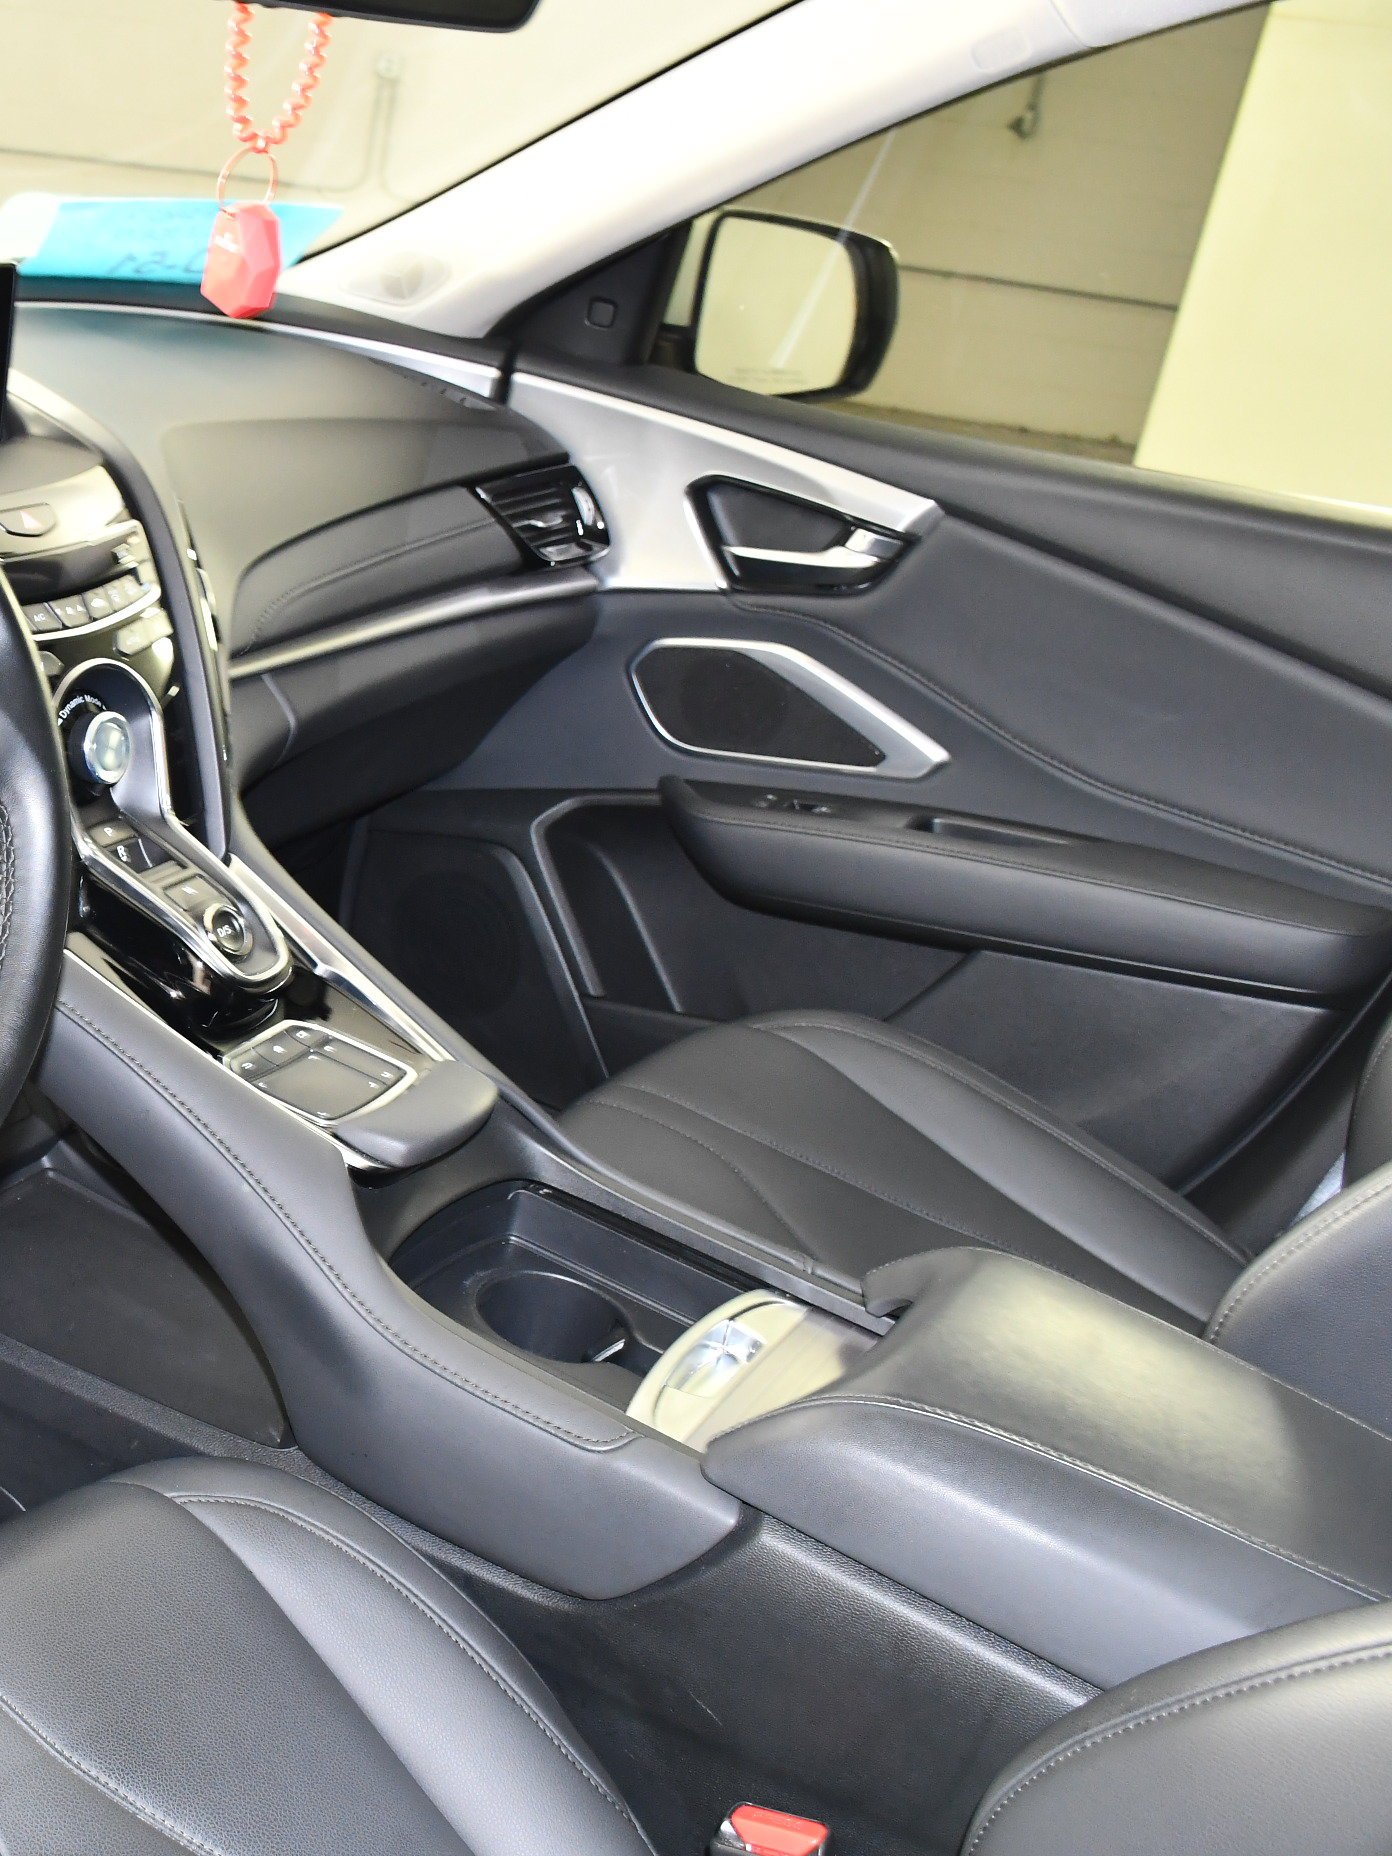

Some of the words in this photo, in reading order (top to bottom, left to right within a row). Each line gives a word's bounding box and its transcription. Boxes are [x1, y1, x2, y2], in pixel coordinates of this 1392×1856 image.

[33, 613, 46, 622] A/C
[59, 695, 84, 718] Dynamic
[84, 695, 102, 707] Mode
[103, 826, 113, 837] P
[216, 924, 233, 938] D/S
